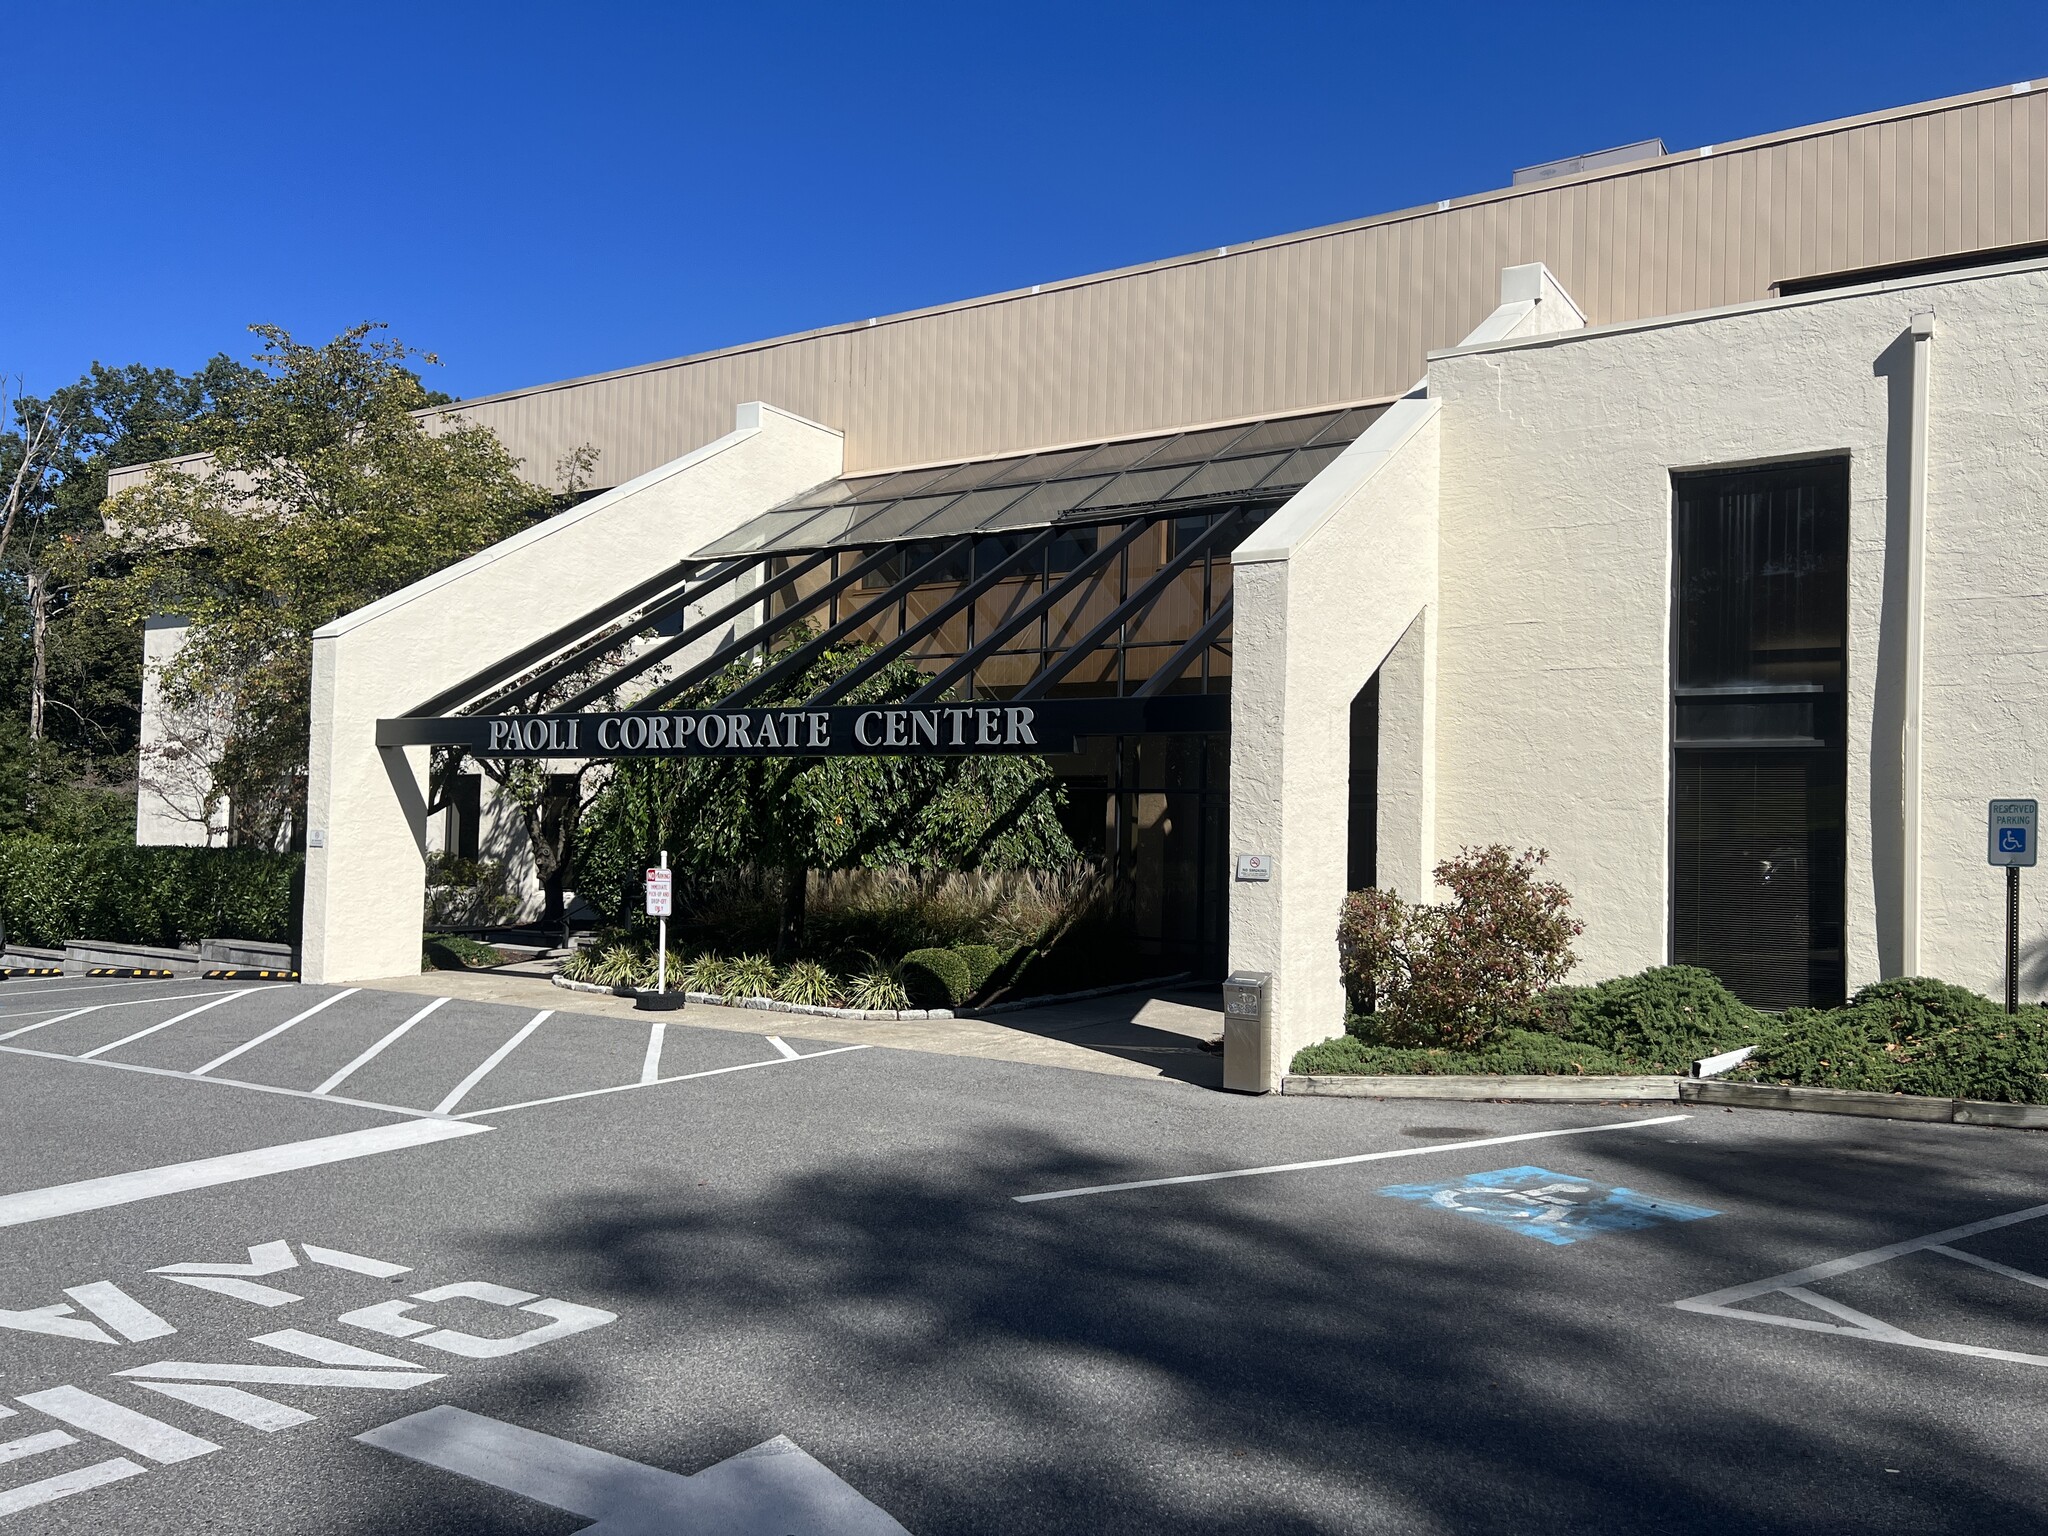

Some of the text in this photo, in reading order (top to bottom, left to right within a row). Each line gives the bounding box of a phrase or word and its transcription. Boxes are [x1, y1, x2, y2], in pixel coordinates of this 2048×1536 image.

[488, 706, 1038, 750] PAOLI CORPORATE CENTER
[1993, 804, 2035, 813] RESERVED
[1997, 816, 2030, 824] PARKING
